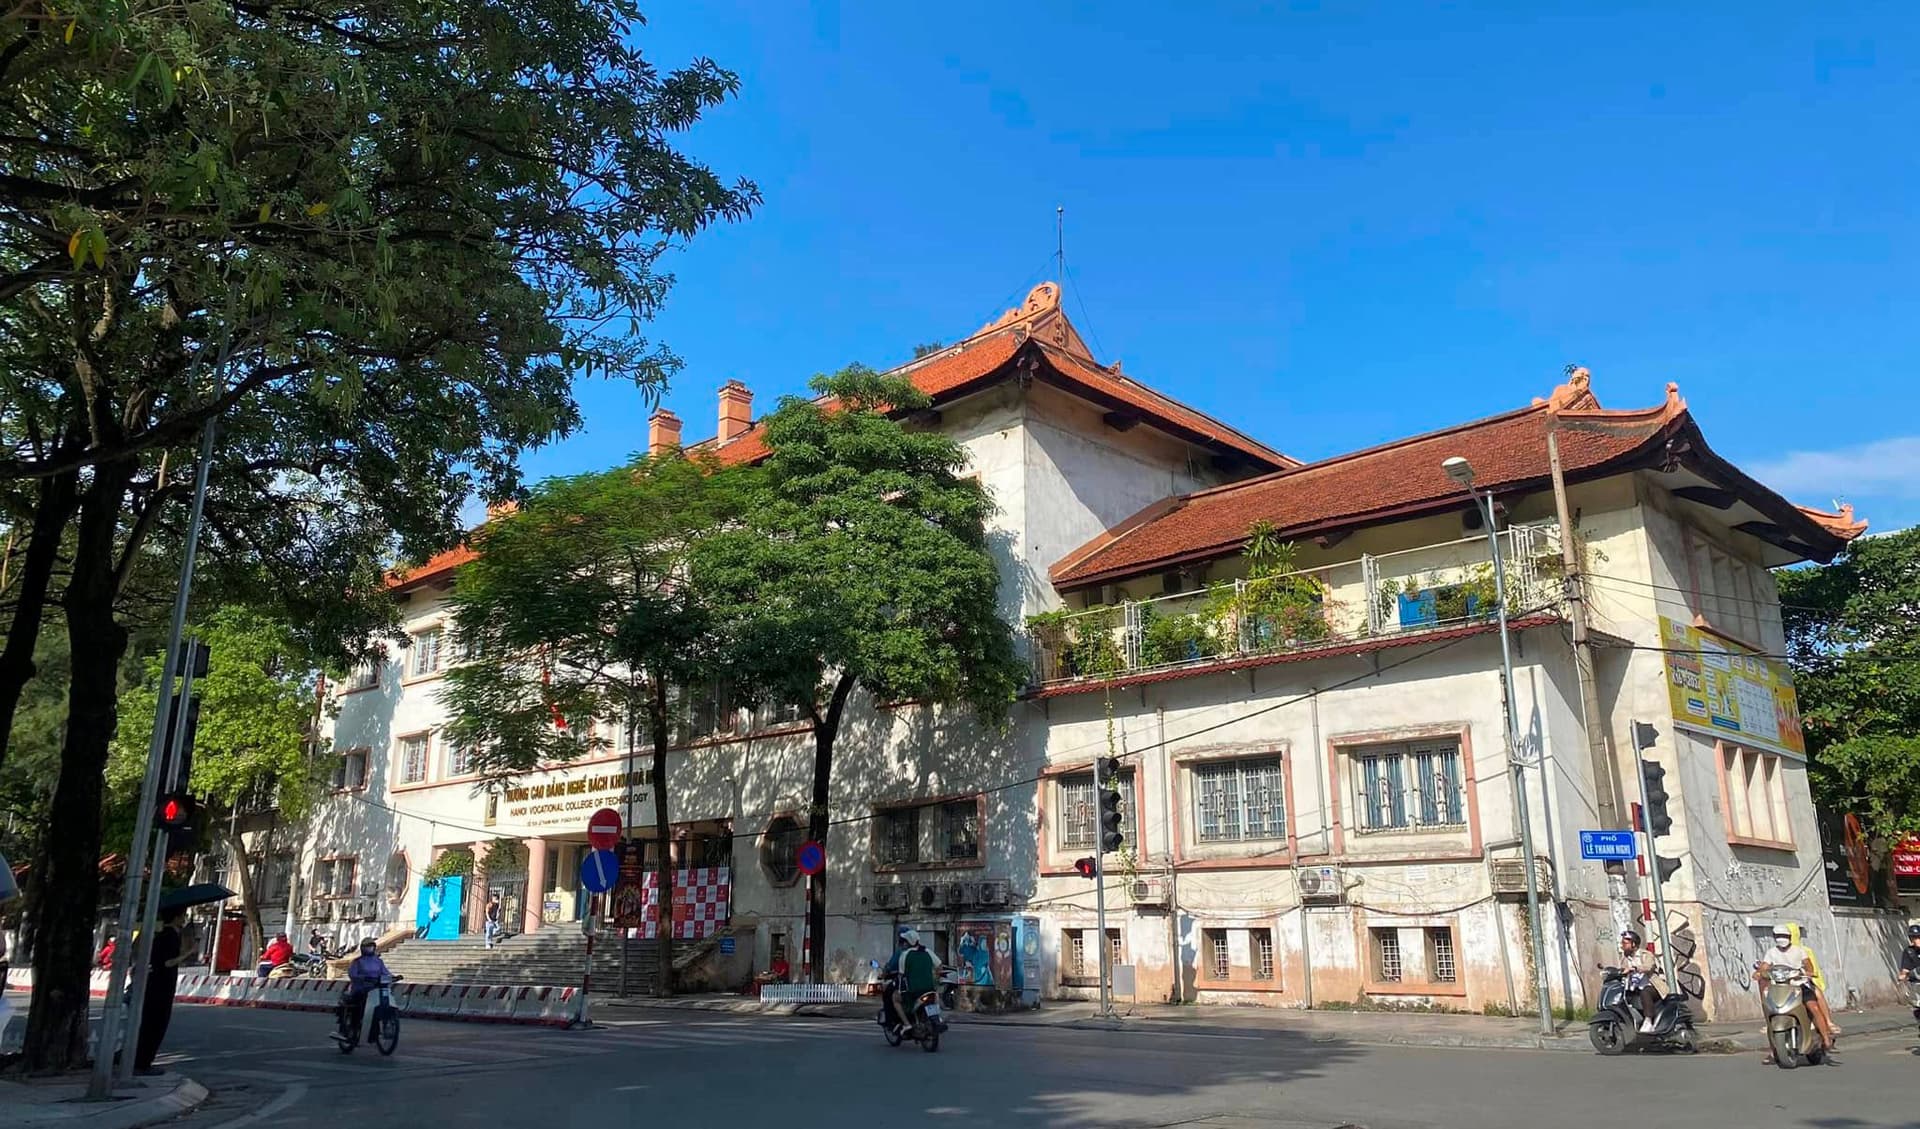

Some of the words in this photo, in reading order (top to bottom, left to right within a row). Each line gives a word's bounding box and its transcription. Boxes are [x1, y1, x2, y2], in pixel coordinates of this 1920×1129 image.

[531, 785, 545, 800] CAO
[588, 773, 608, 793] BÁCH
[510, 807, 527, 817] HANOI
[530, 803, 564, 815] VOCATIONAL
[566, 800, 593, 811] COLLEGE
[594, 797, 603, 807] OF
[605, 792, 648, 806] TECHNOOGY
[1595, 844, 1615, 855] THANH
